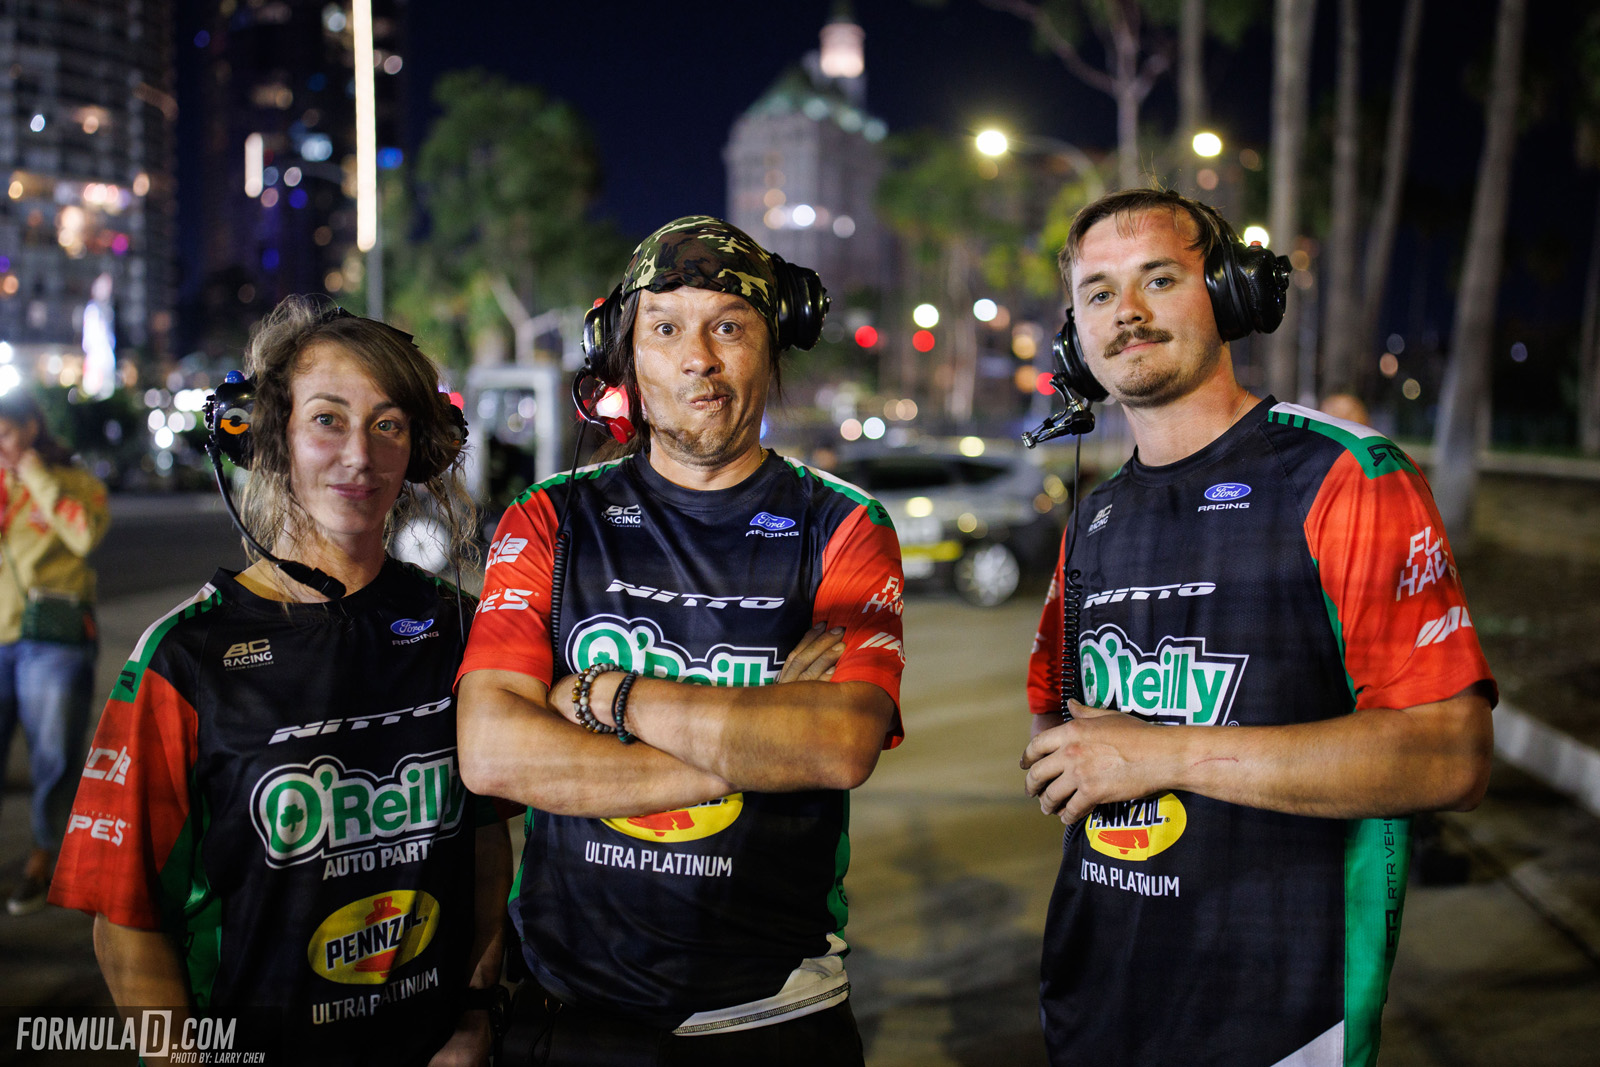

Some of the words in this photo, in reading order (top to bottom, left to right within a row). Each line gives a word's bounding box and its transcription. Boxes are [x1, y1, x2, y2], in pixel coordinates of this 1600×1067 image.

[1212, 485, 1241, 499] Ford
[605, 503, 642, 516] BC
[1197, 502, 1250, 513] RACING
[756, 513, 786, 529] Ford
[745, 530, 800, 538] RACING
[605, 578, 785, 609] NITTO
[1083, 581, 1217, 610] NITTO
[398, 619, 426, 635] Ford
[223, 638, 271, 659] BC
[391, 631, 440, 647] RACING
[223, 651, 273, 668] RACING
[1080, 636, 1227, 724] O'Reilly
[268, 696, 452, 745] NITTO
[322, 850, 376, 881] AUTO
[380, 839, 433, 869] PART
[585, 840, 636, 870] ULTRA
[639, 849, 733, 878] PLATINUM
[1386, 862, 1398, 900] RTR
[312, 996, 367, 1025] ULTRA
